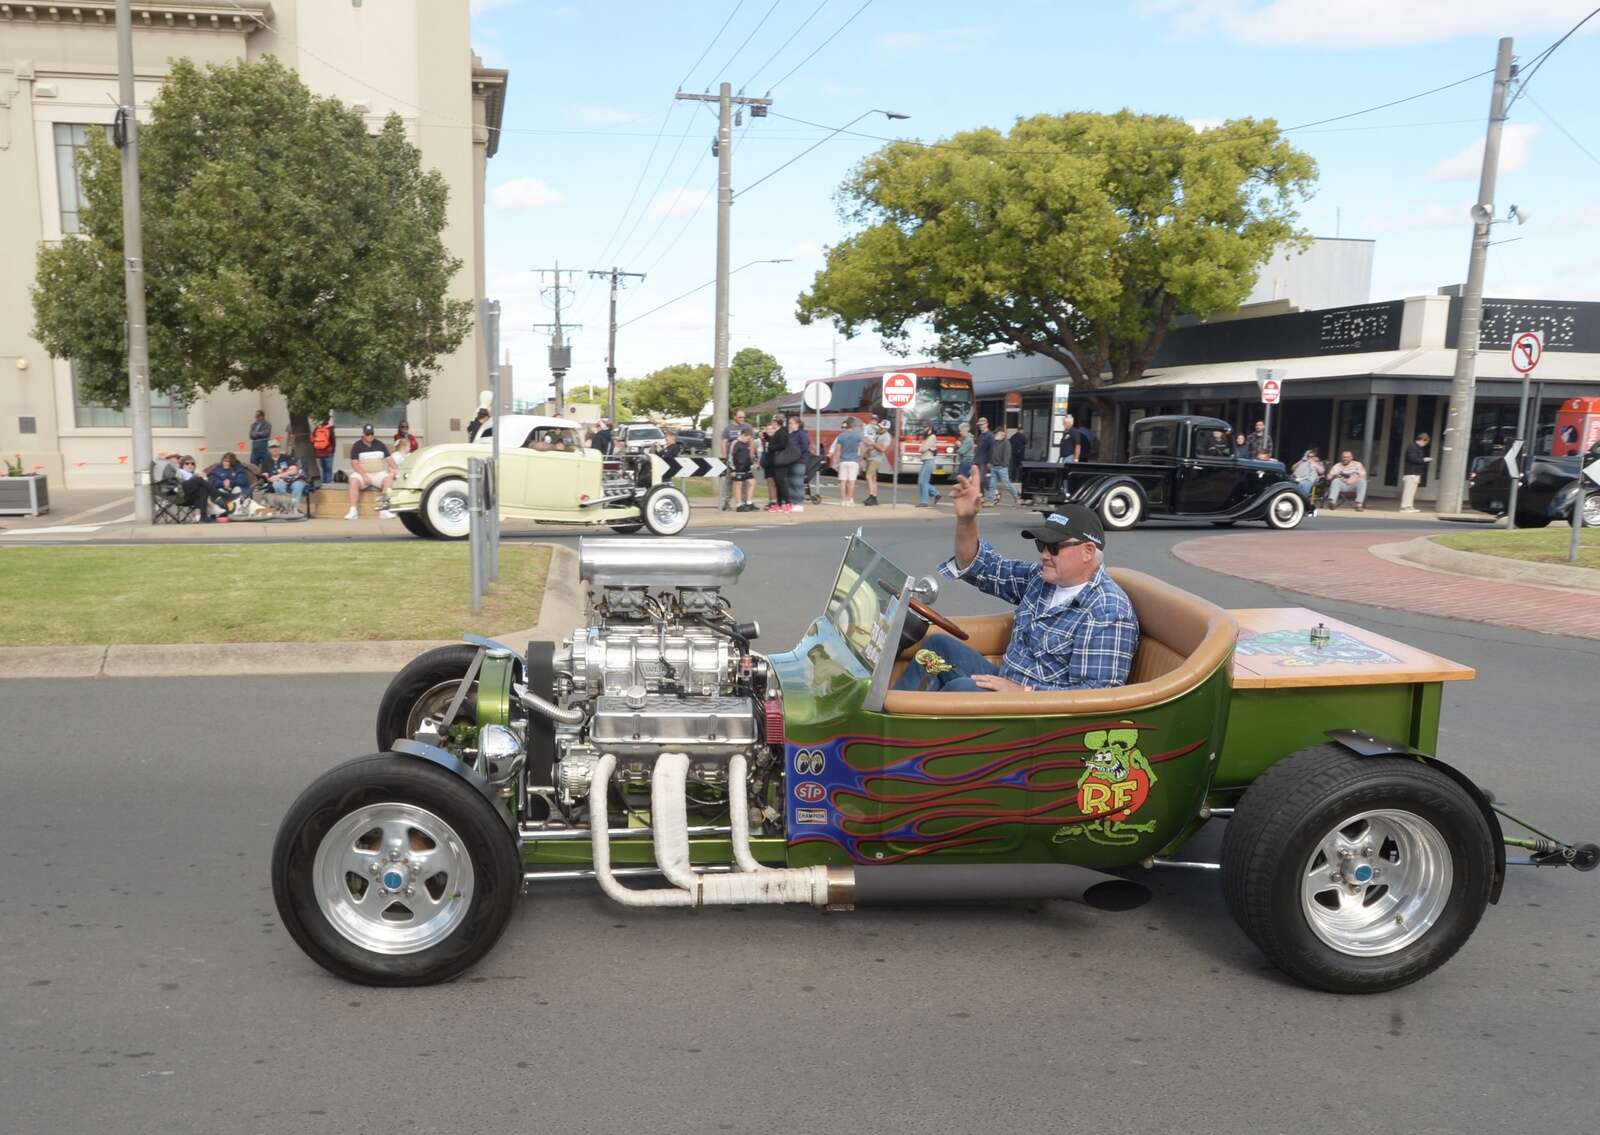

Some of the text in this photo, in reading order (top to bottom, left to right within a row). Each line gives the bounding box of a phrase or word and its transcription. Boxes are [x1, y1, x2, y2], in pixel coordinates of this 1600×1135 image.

[894, 378, 905, 386] NO
[888, 394, 911, 403] ENTRY
[799, 784, 822, 799] STP
